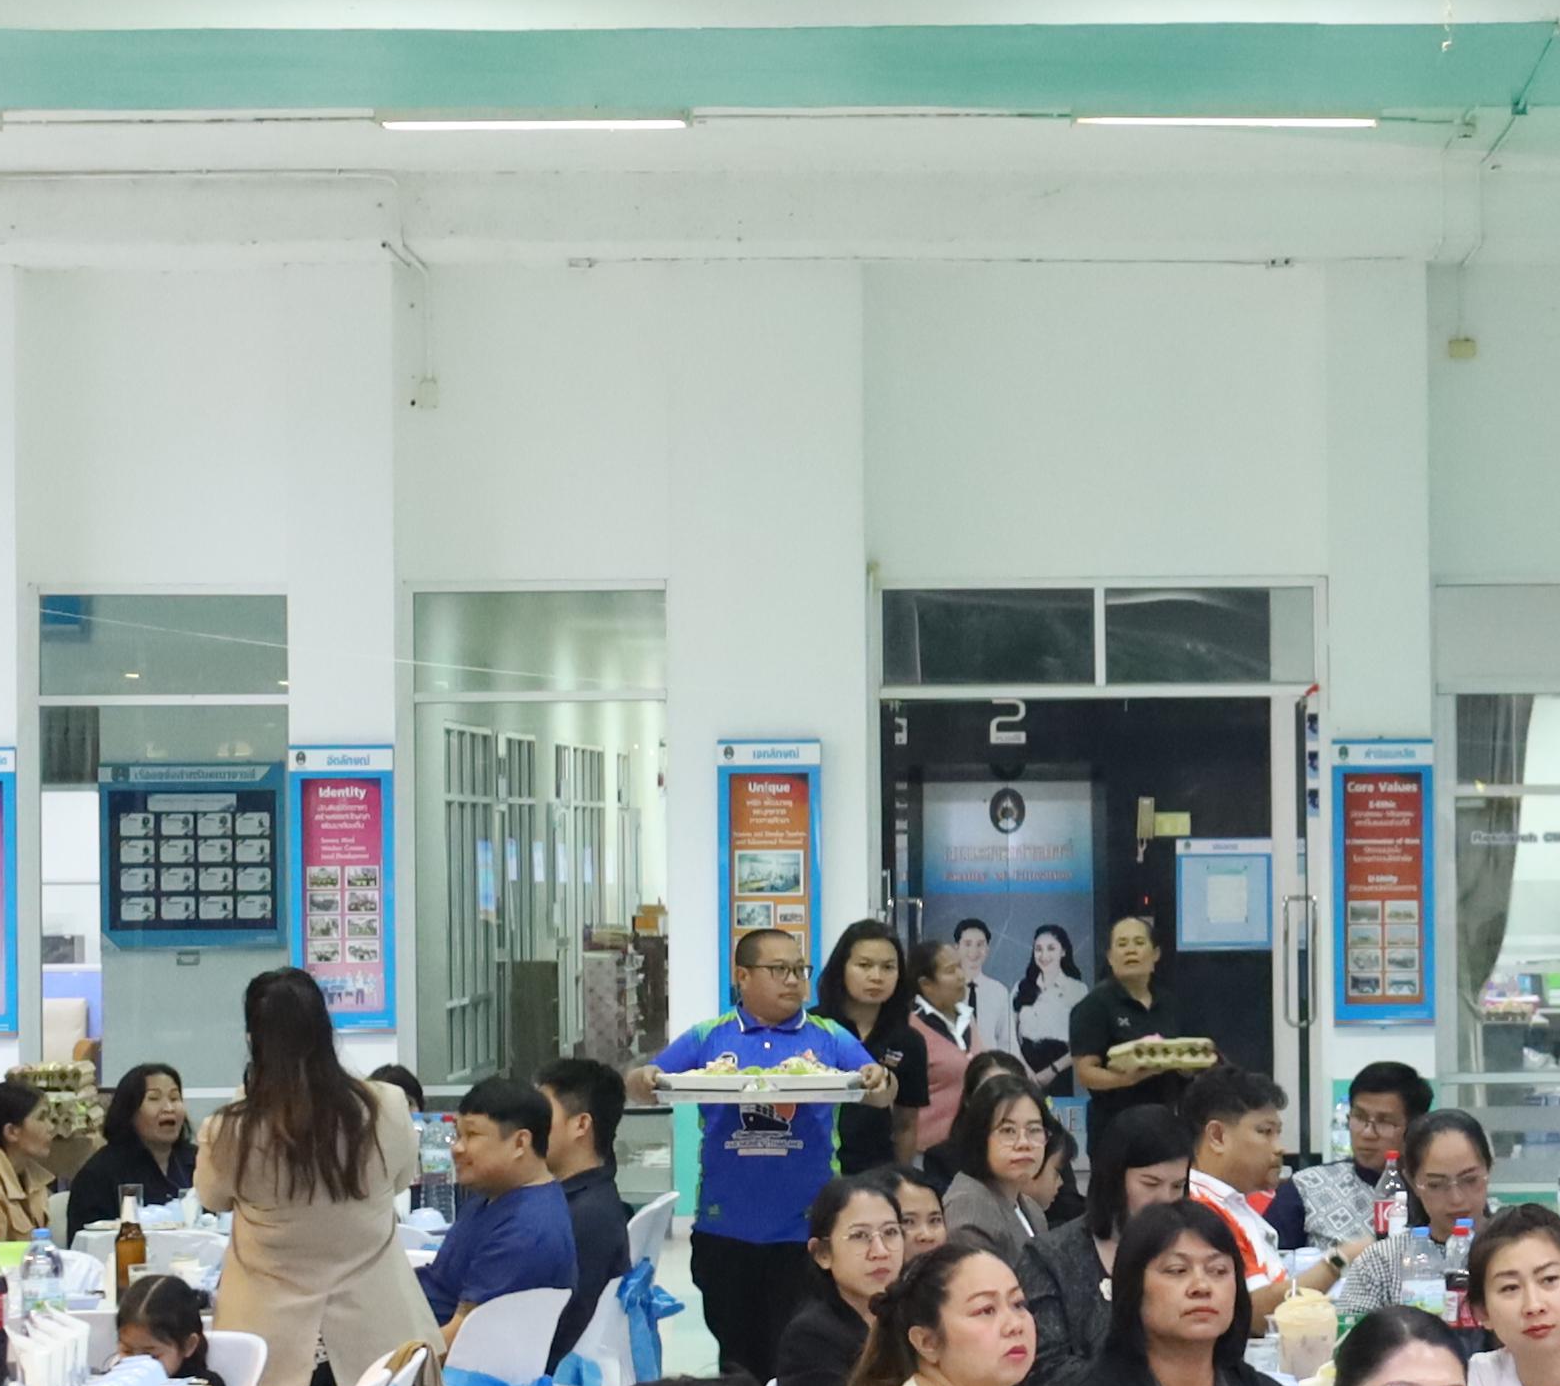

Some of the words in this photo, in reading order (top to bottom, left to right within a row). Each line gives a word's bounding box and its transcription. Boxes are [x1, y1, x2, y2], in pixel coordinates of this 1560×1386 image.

[989, 697, 1027, 745] 2
[318, 786, 367, 800] Identity
[748, 781, 791, 796] Unique
[1347, 781, 1375, 794] Core
[1378, 781, 1418, 794] Values
